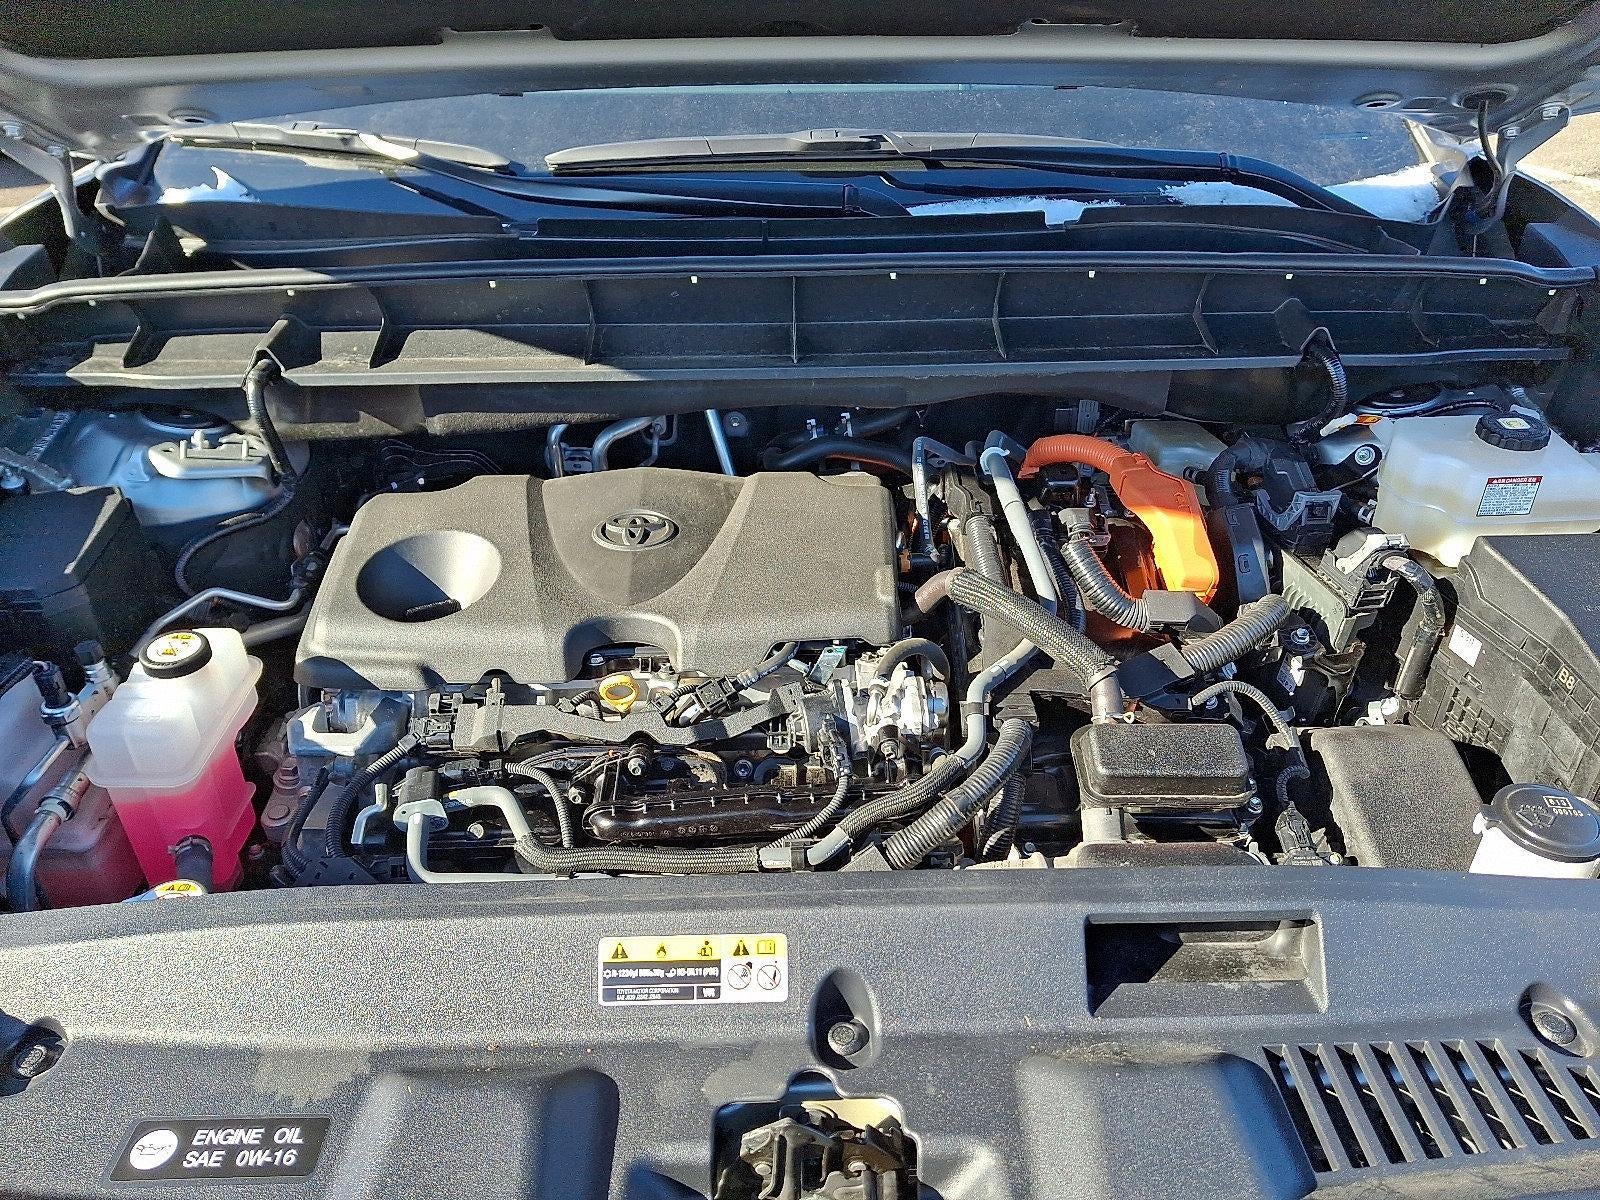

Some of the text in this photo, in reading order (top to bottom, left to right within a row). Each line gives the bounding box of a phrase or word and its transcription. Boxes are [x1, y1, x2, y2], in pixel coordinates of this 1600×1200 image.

[1558, 668, 1575, 690] B8
[191, 1127, 304, 1146] ENGINE OIL
[183, 1149, 298, 1168] SAE 0W-16
